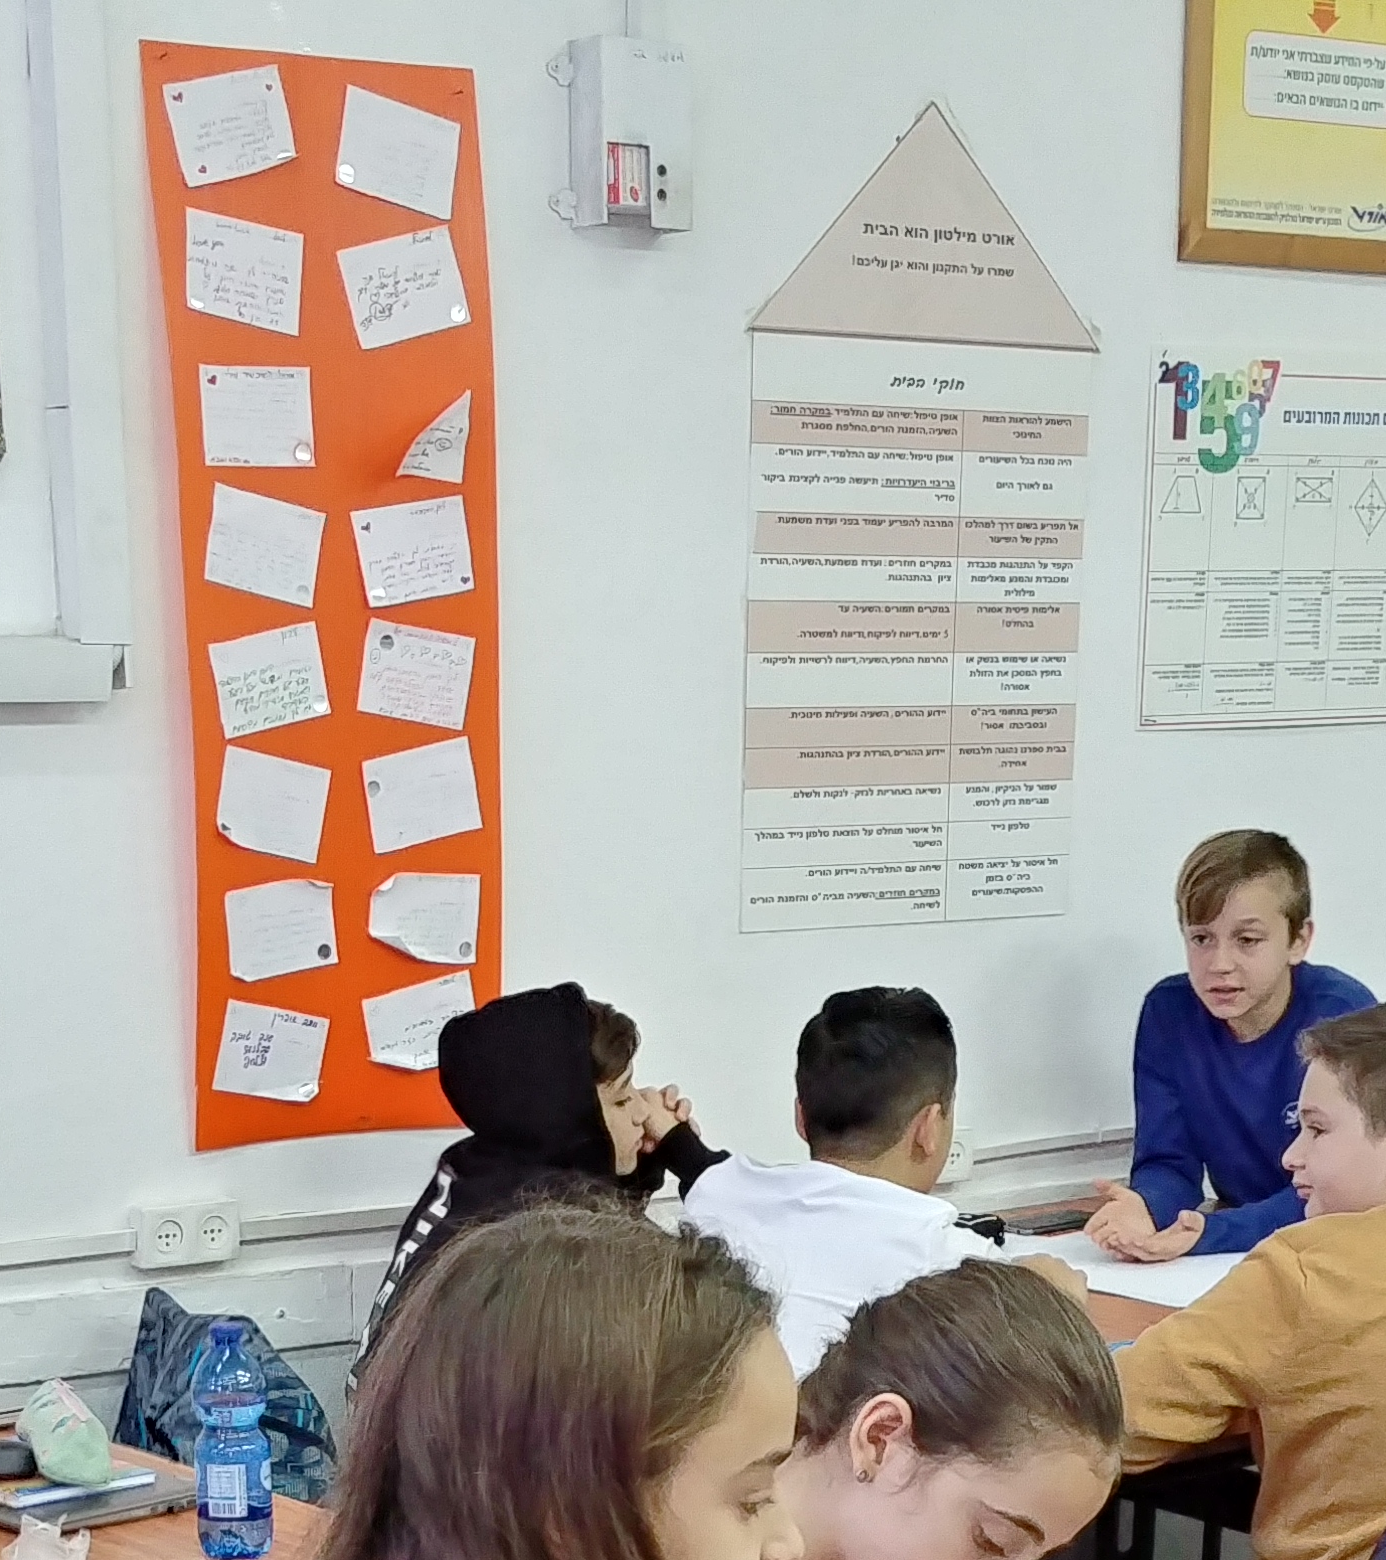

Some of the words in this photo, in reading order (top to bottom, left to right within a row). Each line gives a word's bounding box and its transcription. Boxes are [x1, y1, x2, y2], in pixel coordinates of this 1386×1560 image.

[1281, 49, 1295, 61] אני
[1316, 73, 1340, 86] עוסק
[863, 222, 898, 238] הבית
[904, 225, 928, 240] הוא
[933, 227, 976, 243] מילטון
[981, 230, 1014, 246] אורט
[851, 255, 887, 270] עליכם!
[890, 257, 903, 271] יגן
[906, 259, 928, 273] והוא
[932, 260, 967, 275] התקנון
[970, 263, 984, 276] על
[987, 264, 1014, 278] שמרו
[890, 375, 925, 389] הבית
[933, 377, 964, 391] חוקי
[1177, 363, 1200, 412] 3
[1201, 373, 1227, 427] 4
[799, 406, 831, 417] במקרה
[834, 408, 869, 418] התלמיד
[871, 409, 884, 419] עם
[939, 412, 958, 422] אופן
[1008, 416, 1042, 426] להוראות
[1044, 417, 1071, 427] הישמע
[1282, 411, 1340, 425] המרובעים
[1343, 412, 1380, 426] תכונות
[800, 421, 833, 432] מסגרת
[1236, 403, 1260, 456] 9
[867, 450, 880, 461] עם
[935, 452, 953, 463] אופן
[978, 456, 1017, 466] השיעורים
[1020, 456, 1035, 466] בכל
[1057, 457, 1072, 467] היה
[763, 473, 785, 484] ביקור
[995, 481, 1014, 491] היום
[1017, 481, 1040, 491] לאורך
[1042, 482, 1053, 491] גם
[934, 494, 954, 503] סדיר
[815, 517, 837, 526] ועדת
[839, 517, 859, 527] בפני
[862, 517, 885, 527] יעמוד
[887, 518, 920, 528] להפריע
[922, 518, 953, 528] המרבה
[998, 521, 1014, 530] דרך
[1016, 521, 1038, 531] בשום
[1040, 521, 1065, 531] תפריע
[1068, 522, 1078, 531] אל
[1020, 535, 1032, 544] של
[1034, 535, 1058, 545] התקין
[860, 558, 882, 569] ועדת
[919, 559, 951, 569] במקרים
[966, 560, 997, 570] מכבדת
[999, 560, 1035, 570] התנהגות
[1037, 560, 1048, 571] על
[1051, 560, 1073, 571] הקפד
[937, 574, 951, 583] ציון
[1008, 574, 1033, 584] והמנע
[838, 604, 850, 614] עד
[917, 604, 949, 614] במקרים
[976, 605, 1002, 614] אסורה
[1031, 605, 1060, 614] אלימות
[917, 656, 948, 665] החרמת
[965, 656, 974, 665] או
[976, 655, 999, 665] בנשק
[1001, 655, 1027, 665] שימוש
[1029, 655, 1038, 665] או
[1041, 655, 1066, 665] נשיאה
[996, 669, 1009, 679] את
[1010, 669, 1037, 679] המסכן
[1039, 668, 1061, 679] בחפץ
[860, 709, 889, 719] השעיה
[998, 707, 1028, 716] בתחומי
[1030, 707, 1057, 716] העישון
[846, 749, 860, 759] ציון
[1046, 745, 1066, 754] בבית
[876, 788, 912, 798] באחריות
[914, 787, 941, 797] נשיאה
[1024, 783, 1034, 793] על
[1036, 783, 1057, 793] שמור
[905, 826, 928, 836] איסור
[931, 826, 942, 835] חל
[990, 823, 1005, 832] נייד
[1007, 822, 1029, 832] טלפון
[754, 830, 784, 841] במהלך
[787, 830, 803, 840] נייד
[805, 829, 829, 840] טלפון
[862, 828, 873, 838] על
[958, 860, 984, 871] משטח
[1010, 858, 1020, 868] על
[1047, 857, 1058, 867] חל
[904, 865, 916, 874] עם
[918, 864, 941, 874] שיחה
[749, 894, 774, 905] הורים
[777, 893, 808, 904] והזמנת
